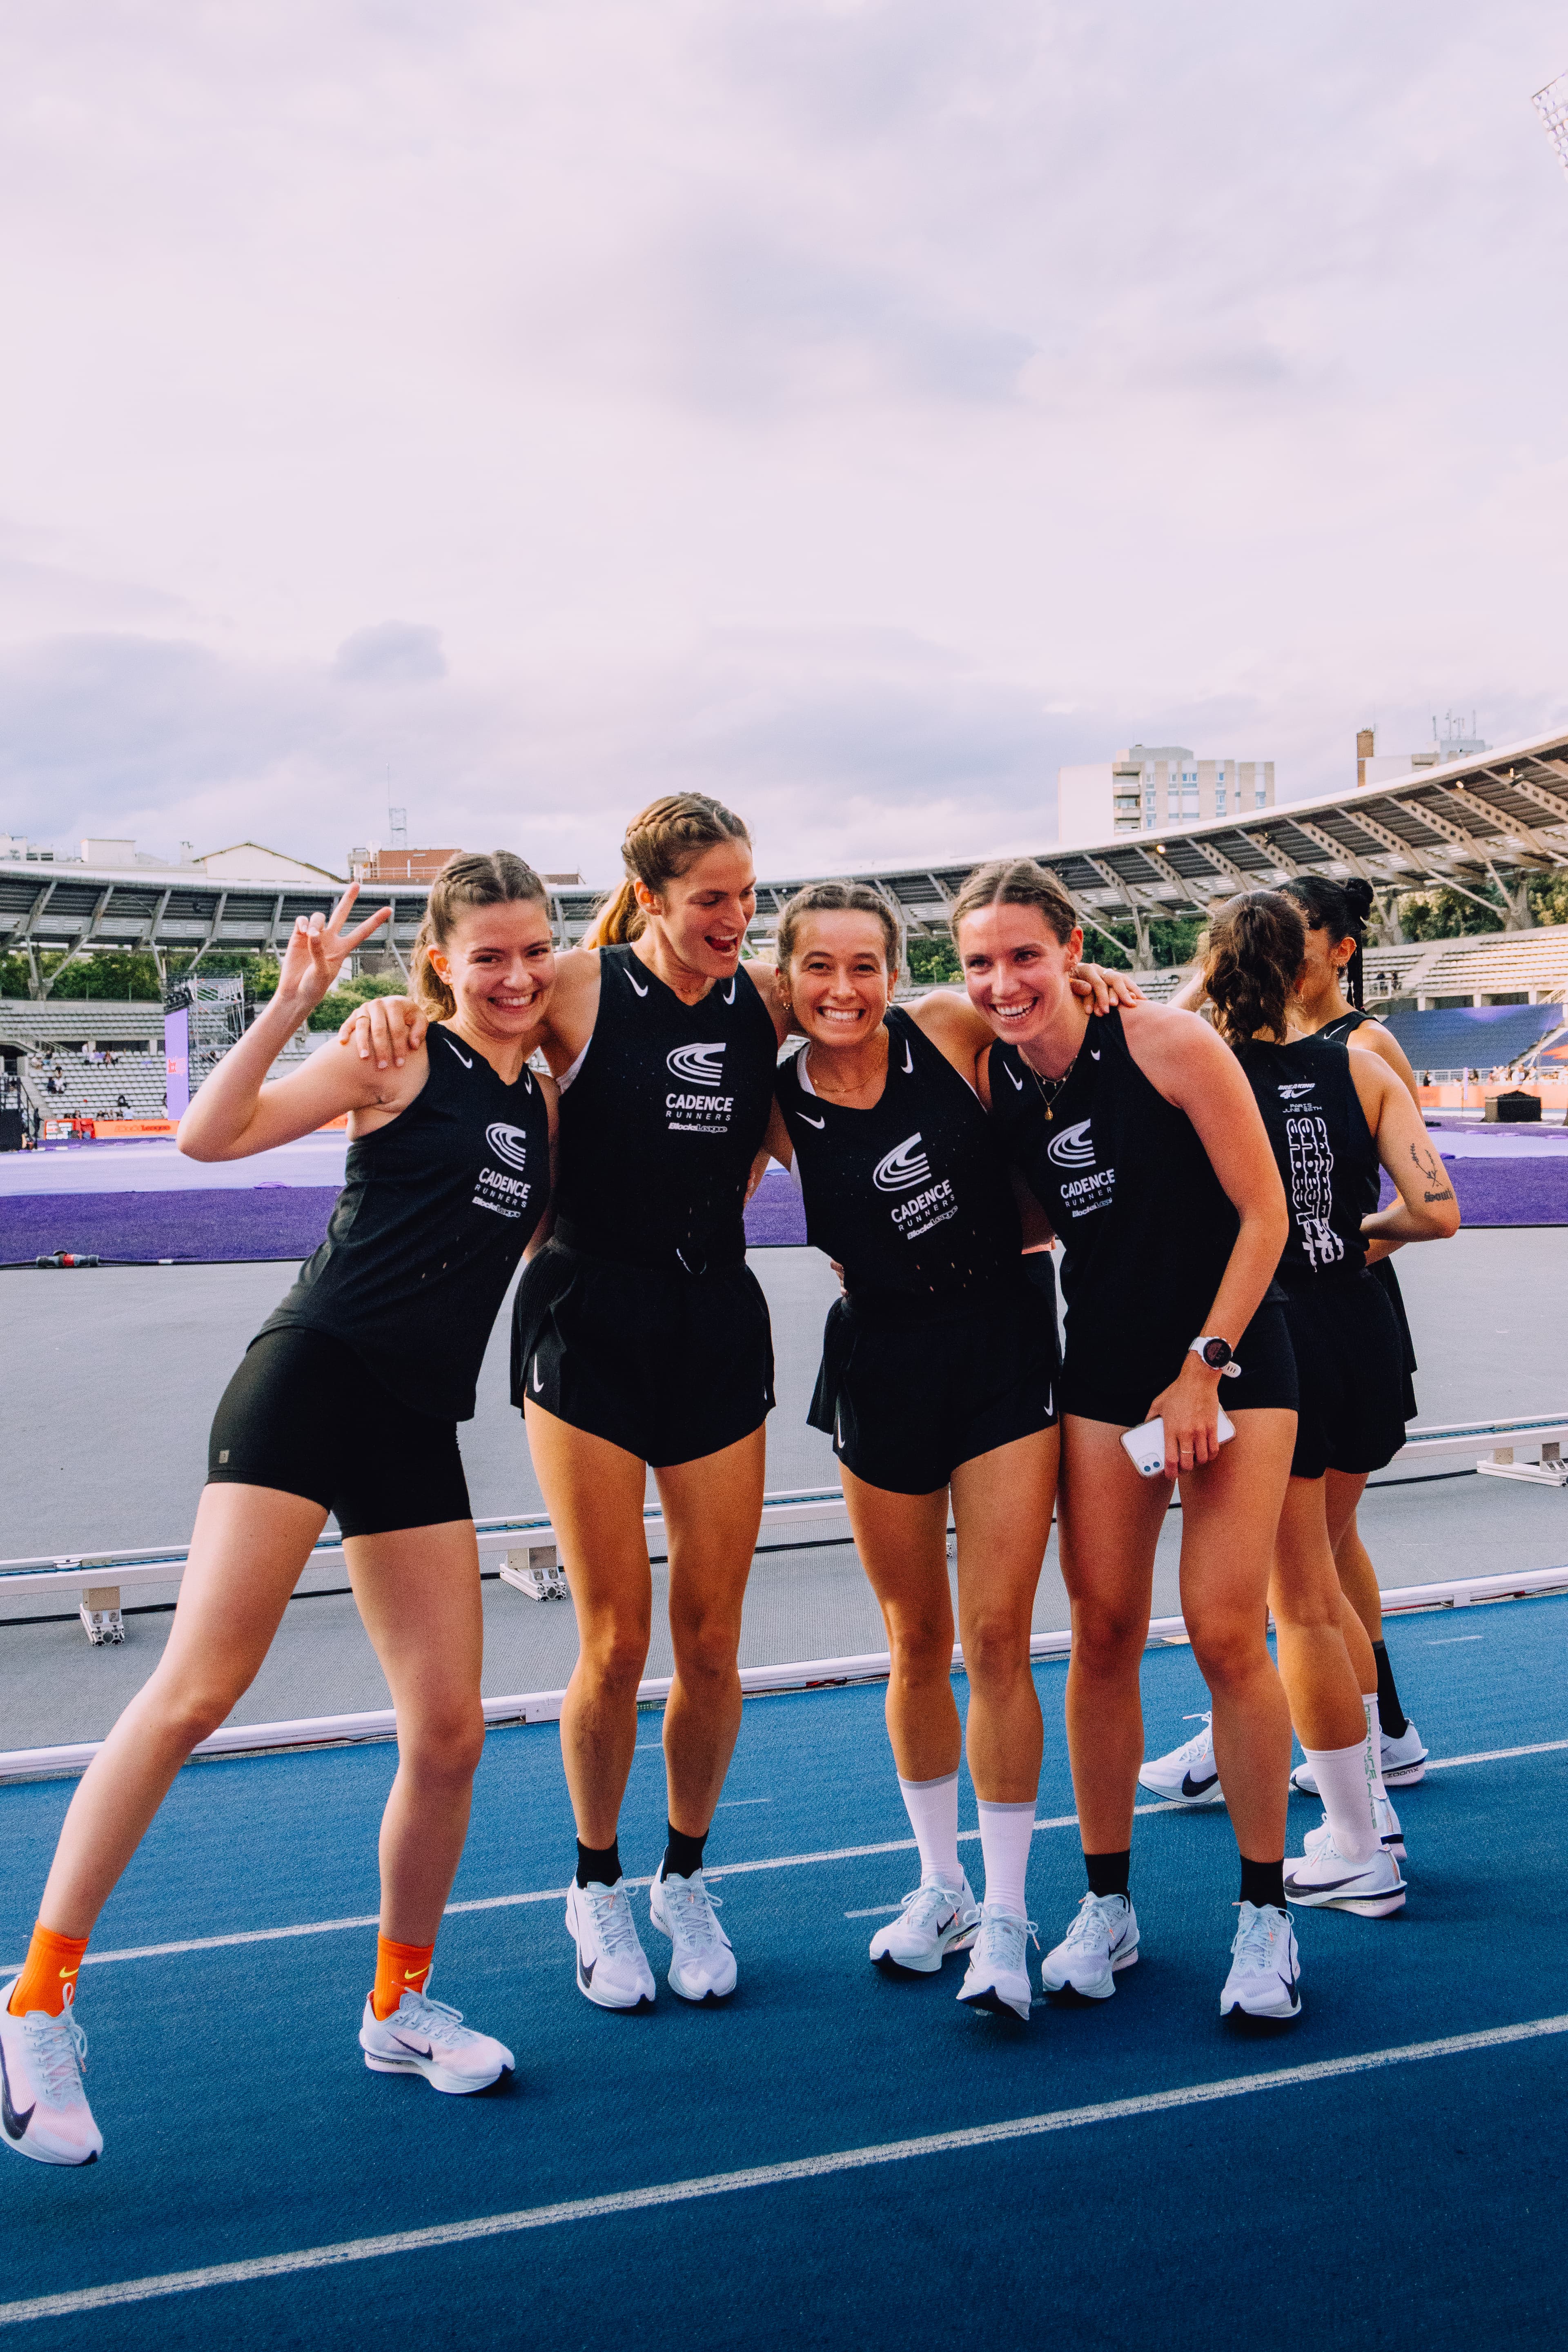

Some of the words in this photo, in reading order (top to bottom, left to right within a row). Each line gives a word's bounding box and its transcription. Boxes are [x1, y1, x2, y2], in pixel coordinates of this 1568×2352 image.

[666, 1093, 734, 1112] CADENCE
[1280, 1089, 1292, 1099] 4
[666, 1110, 731, 1121] RUNNERS
[474, 1184, 527, 1208] RUNNERS
[479, 1167, 531, 1199] CADENCE
[1060, 1169, 1115, 1198] CADENCE
[891, 1179, 952, 1223] CADENCE
[898, 1194, 955, 1232] RUNNERS
